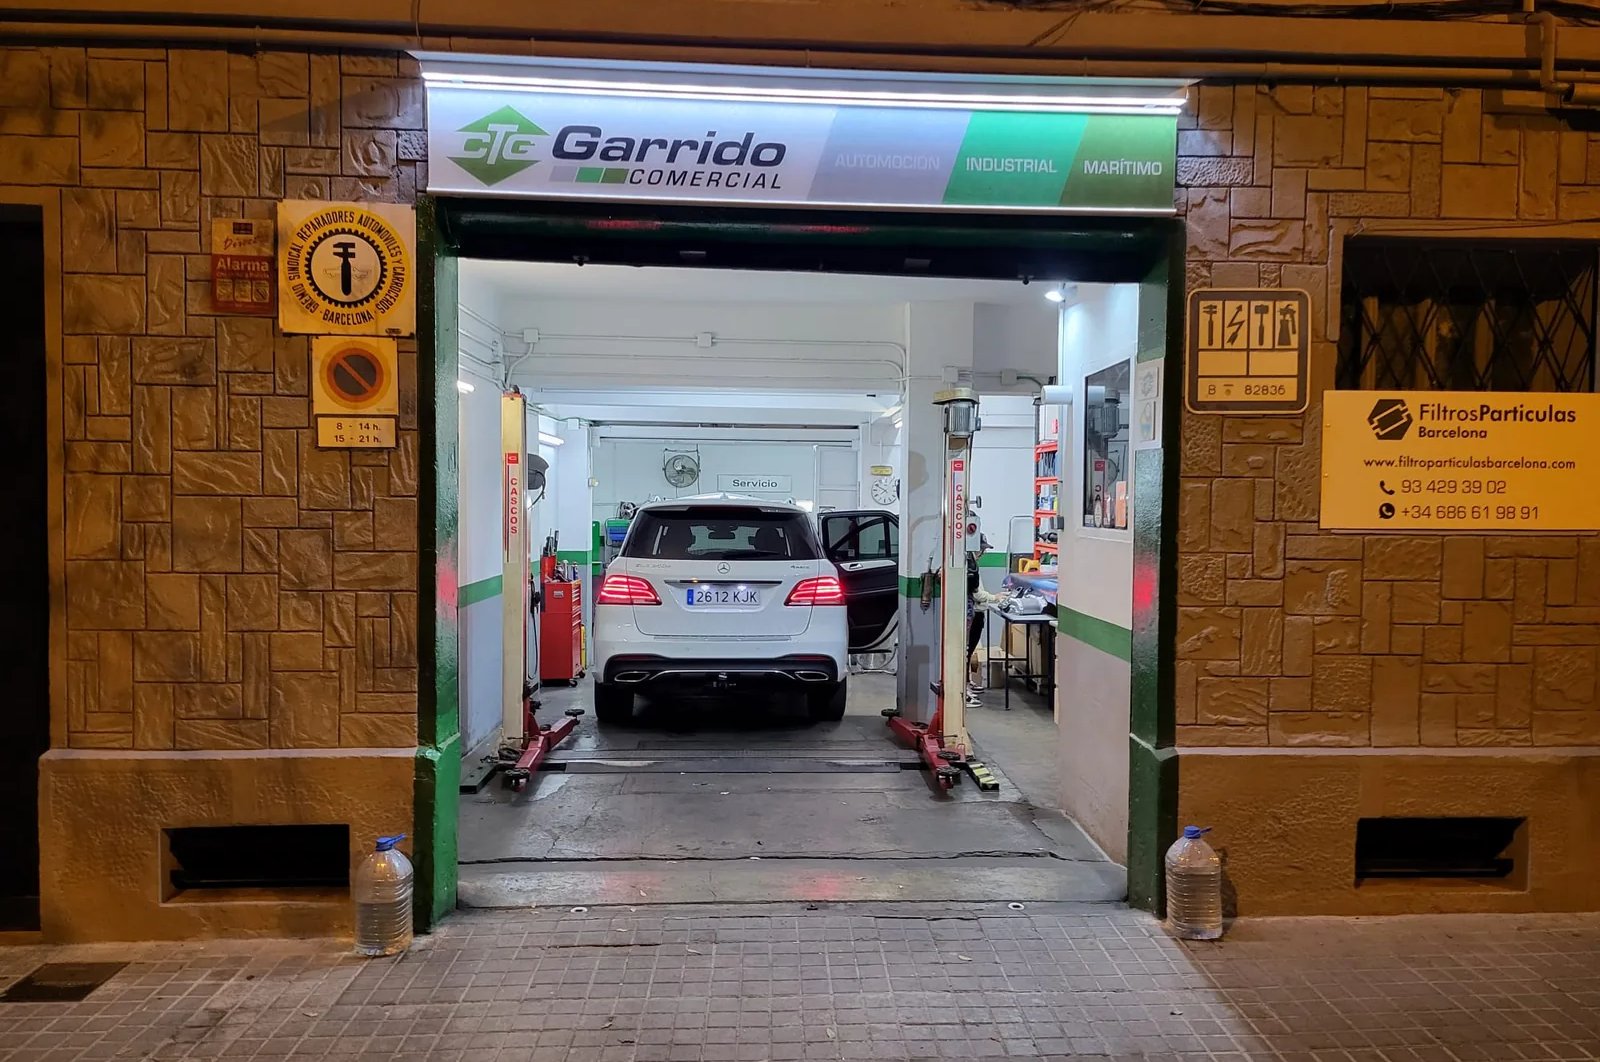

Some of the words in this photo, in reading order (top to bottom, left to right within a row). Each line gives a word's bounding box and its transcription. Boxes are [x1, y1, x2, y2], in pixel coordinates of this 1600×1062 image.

[551, 125, 787, 167] Garrido
[966, 157, 1058, 174] INDUSTRIAL
[1083, 157, 1163, 176] MARÍTIMO
[629, 168, 782, 190] COMERCIAL
[296, 210, 355, 242] REPARADORES
[357, 213, 402, 258] AUTOMOVILES
[217, 257, 269, 271] Alarma
[287, 242, 304, 281] SINDICAL
[291, 283, 320, 314] GREMIO
[375, 266, 406, 314] CARROCEROS
[322, 309, 375, 326] BARCELONA
[1208, 385, 1216, 395] B
[1419, 403, 1577, 423] FiltrosParticulas
[336, 422, 343, 431] 8
[359, 422, 370, 431] 14
[373, 422, 381, 431] h.
[1418, 426, 1488, 439] Barcelona
[334, 434, 345, 443] 15
[358, 434, 370, 443] 21
[373, 434, 382, 443] h.
[1363, 456, 1576, 471] www.filtroparticulasbarcelona.com
[732, 479, 778, 489] Servicio
[1401, 479, 1422, 494] 93
[1426, 479, 1457, 494] 429
[1461, 479, 1482, 494] 39
[1486, 480, 1507, 494] 02
[510, 477, 518, 534] CASCOS
[955, 484, 963, 539] CASCOS
[1401, 505, 1431, 519] +34
[1436, 505, 1467, 519] 686
[1471, 505, 1489, 519] 61
[1495, 505, 1516, 519] 98
[1520, 505, 1539, 519] 91
[696, 591, 729, 603] 2612
[733, 591, 757, 603] KJK
